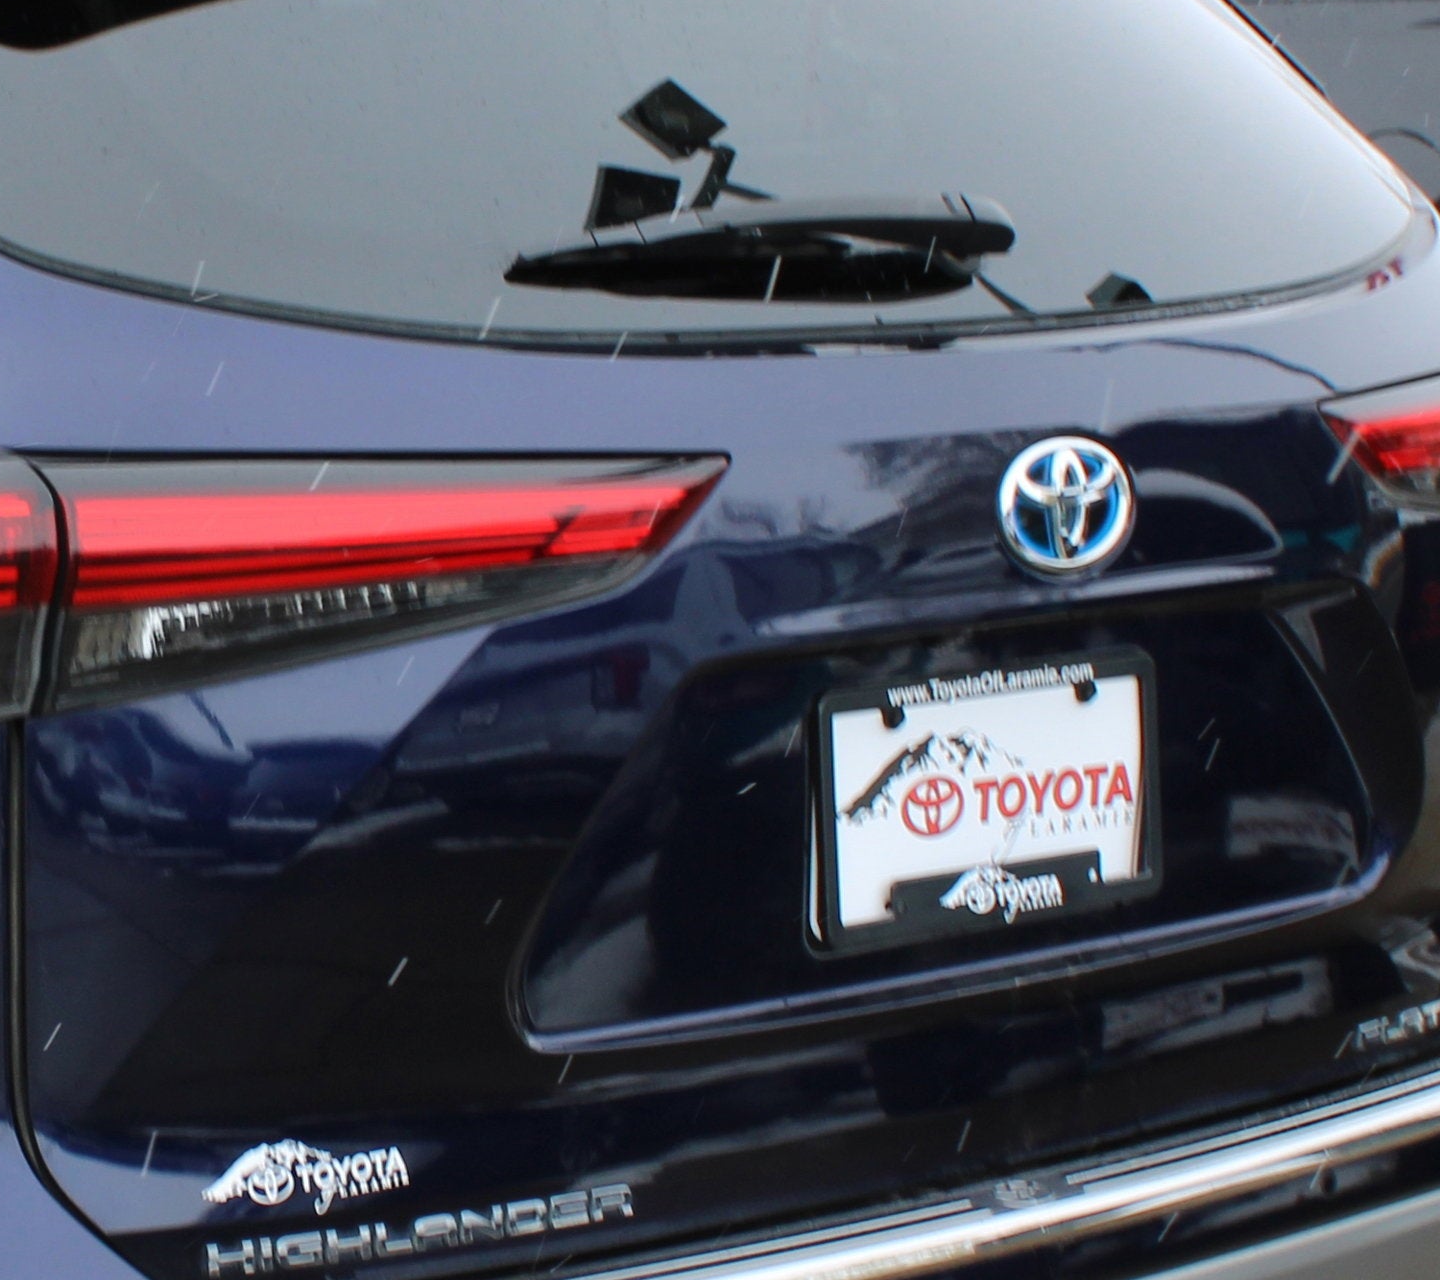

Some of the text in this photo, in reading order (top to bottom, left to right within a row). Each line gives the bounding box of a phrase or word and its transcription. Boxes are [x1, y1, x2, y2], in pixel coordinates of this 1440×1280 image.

[887, 662, 1095, 708] www.ToyotaOfLaramie.com
[973, 760, 1133, 824] TOYOTA
[295, 1145, 409, 1194] TOYOTA
[205, 1182, 635, 1279] HIGHLANDER
